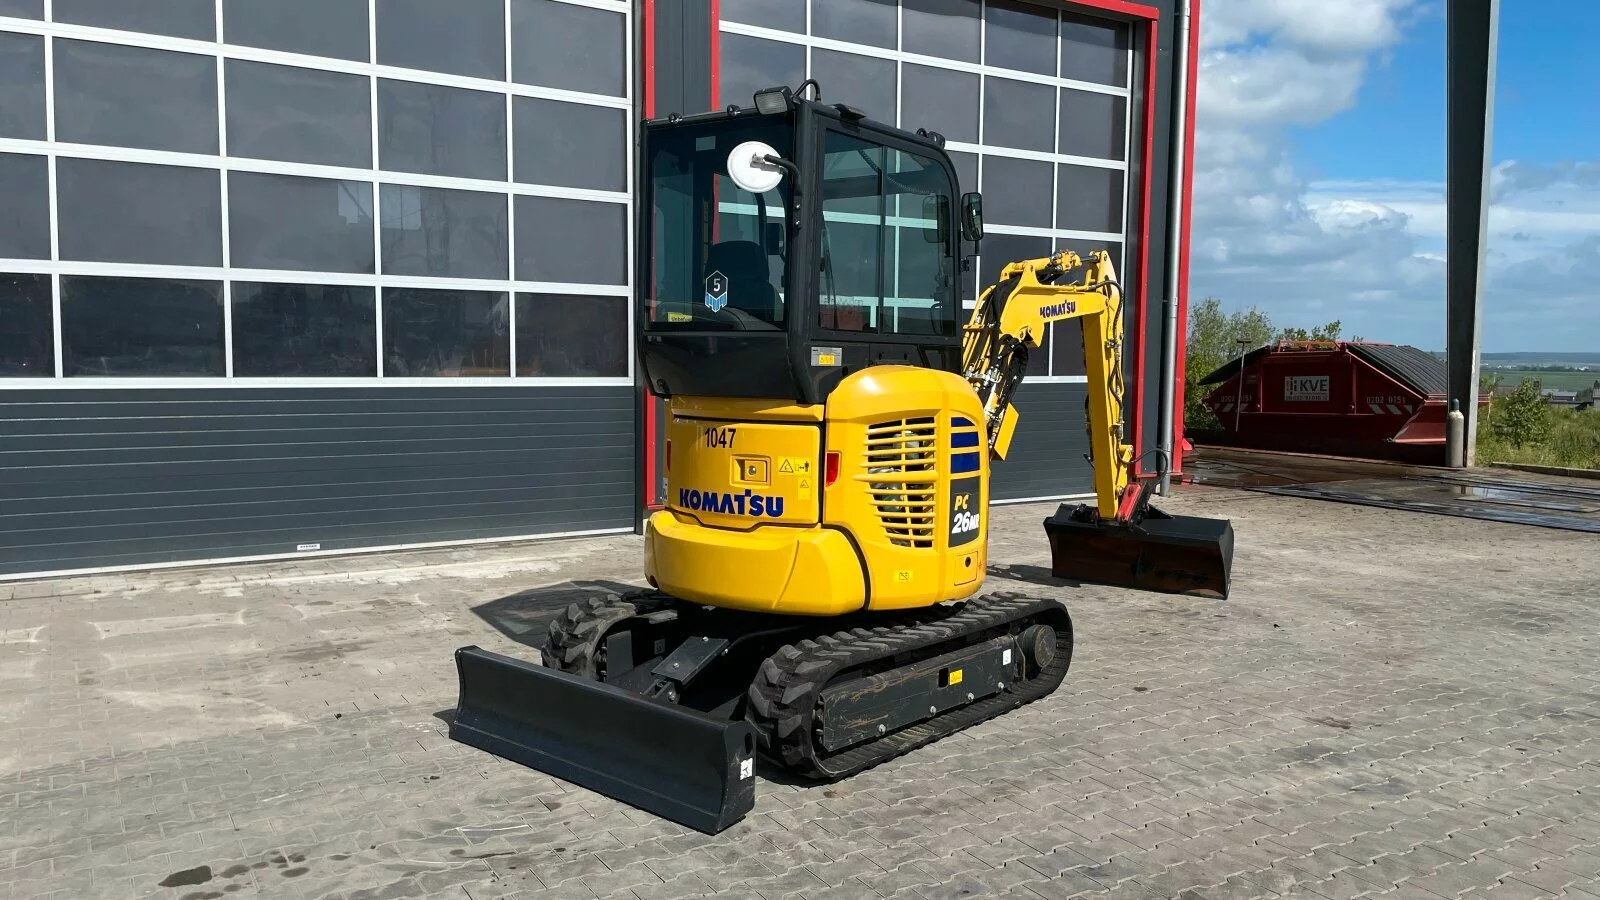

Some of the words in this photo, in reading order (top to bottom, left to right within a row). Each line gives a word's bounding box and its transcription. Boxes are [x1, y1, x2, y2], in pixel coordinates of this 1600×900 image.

[713, 278, 721, 292] 5
[1039, 299, 1076, 318] KOMATSU
[1300, 379, 1328, 391] KVE
[704, 427, 737, 449] 1047
[679, 488, 784, 518] KOMATSU
[954, 494, 970, 511] PC
